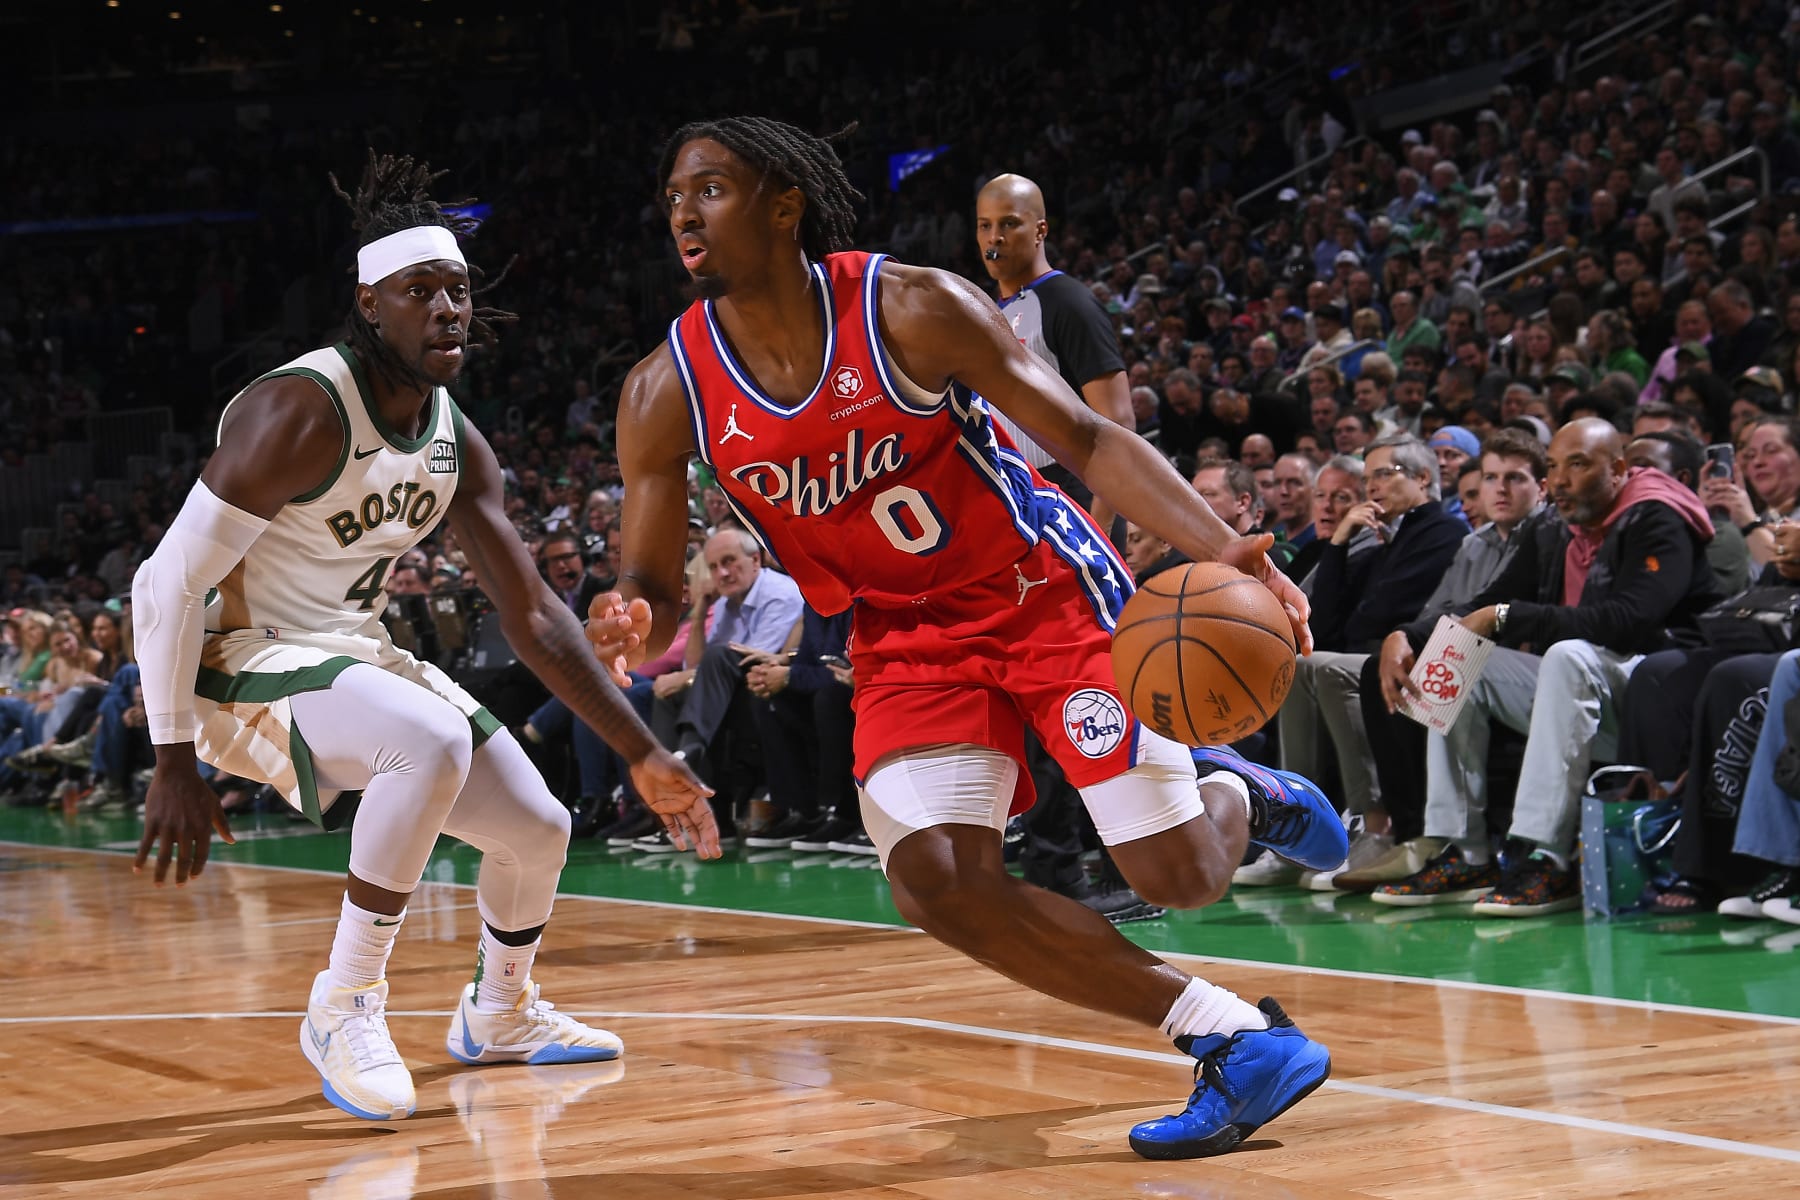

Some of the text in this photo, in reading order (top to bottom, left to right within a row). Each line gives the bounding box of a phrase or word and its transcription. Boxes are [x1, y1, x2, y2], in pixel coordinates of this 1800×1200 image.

[830, 394, 884, 420] crypto.com
[430, 459, 456, 472] PRINT
[730, 428, 910, 517] Phila
[325, 481, 443, 549] BOSTO
[870, 485, 953, 556] 0
[343, 556, 397, 610] 4
[1426, 662, 1454, 683] POP
[1422, 679, 1460, 700] CORN
[1068, 716, 1121, 743] 76ers
